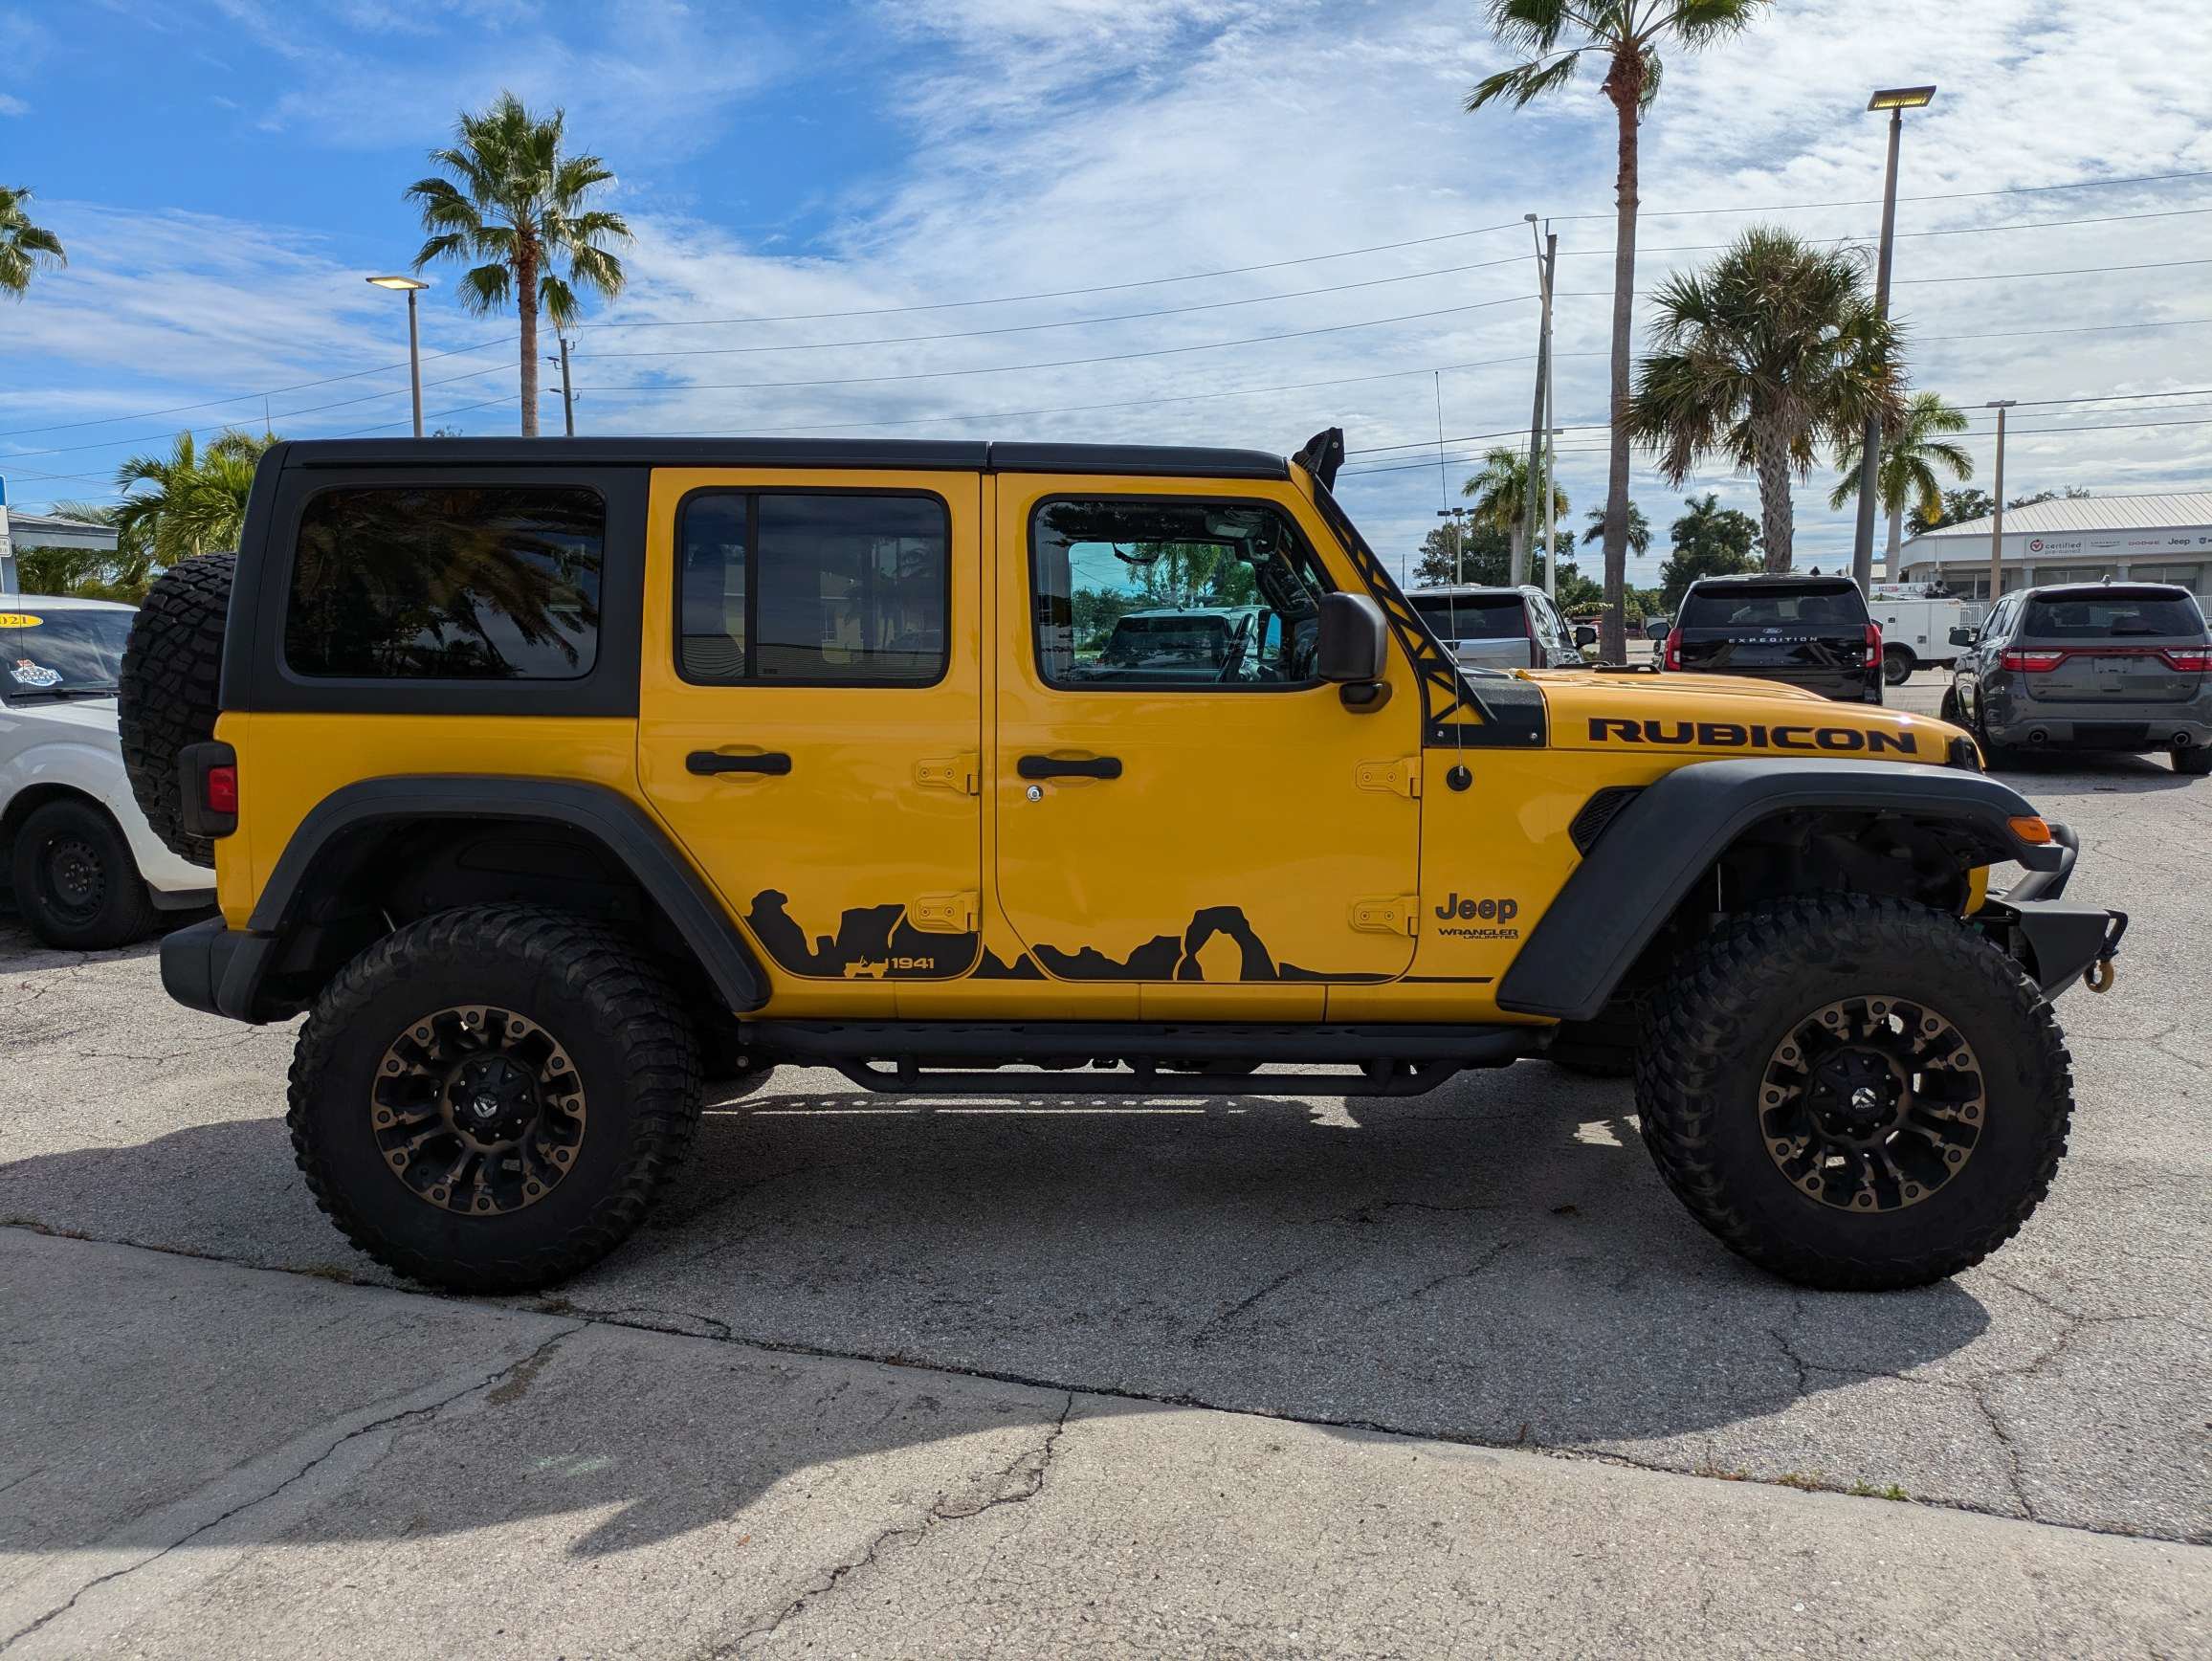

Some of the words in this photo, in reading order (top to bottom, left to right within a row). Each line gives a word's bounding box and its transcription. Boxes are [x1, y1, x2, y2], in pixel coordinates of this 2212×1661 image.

[2168, 538, 2190, 546] Jeep
[1588, 717, 1917, 754] RUBICON
[1435, 893, 1518, 924] Jeep
[892, 957, 935, 970] 1941
